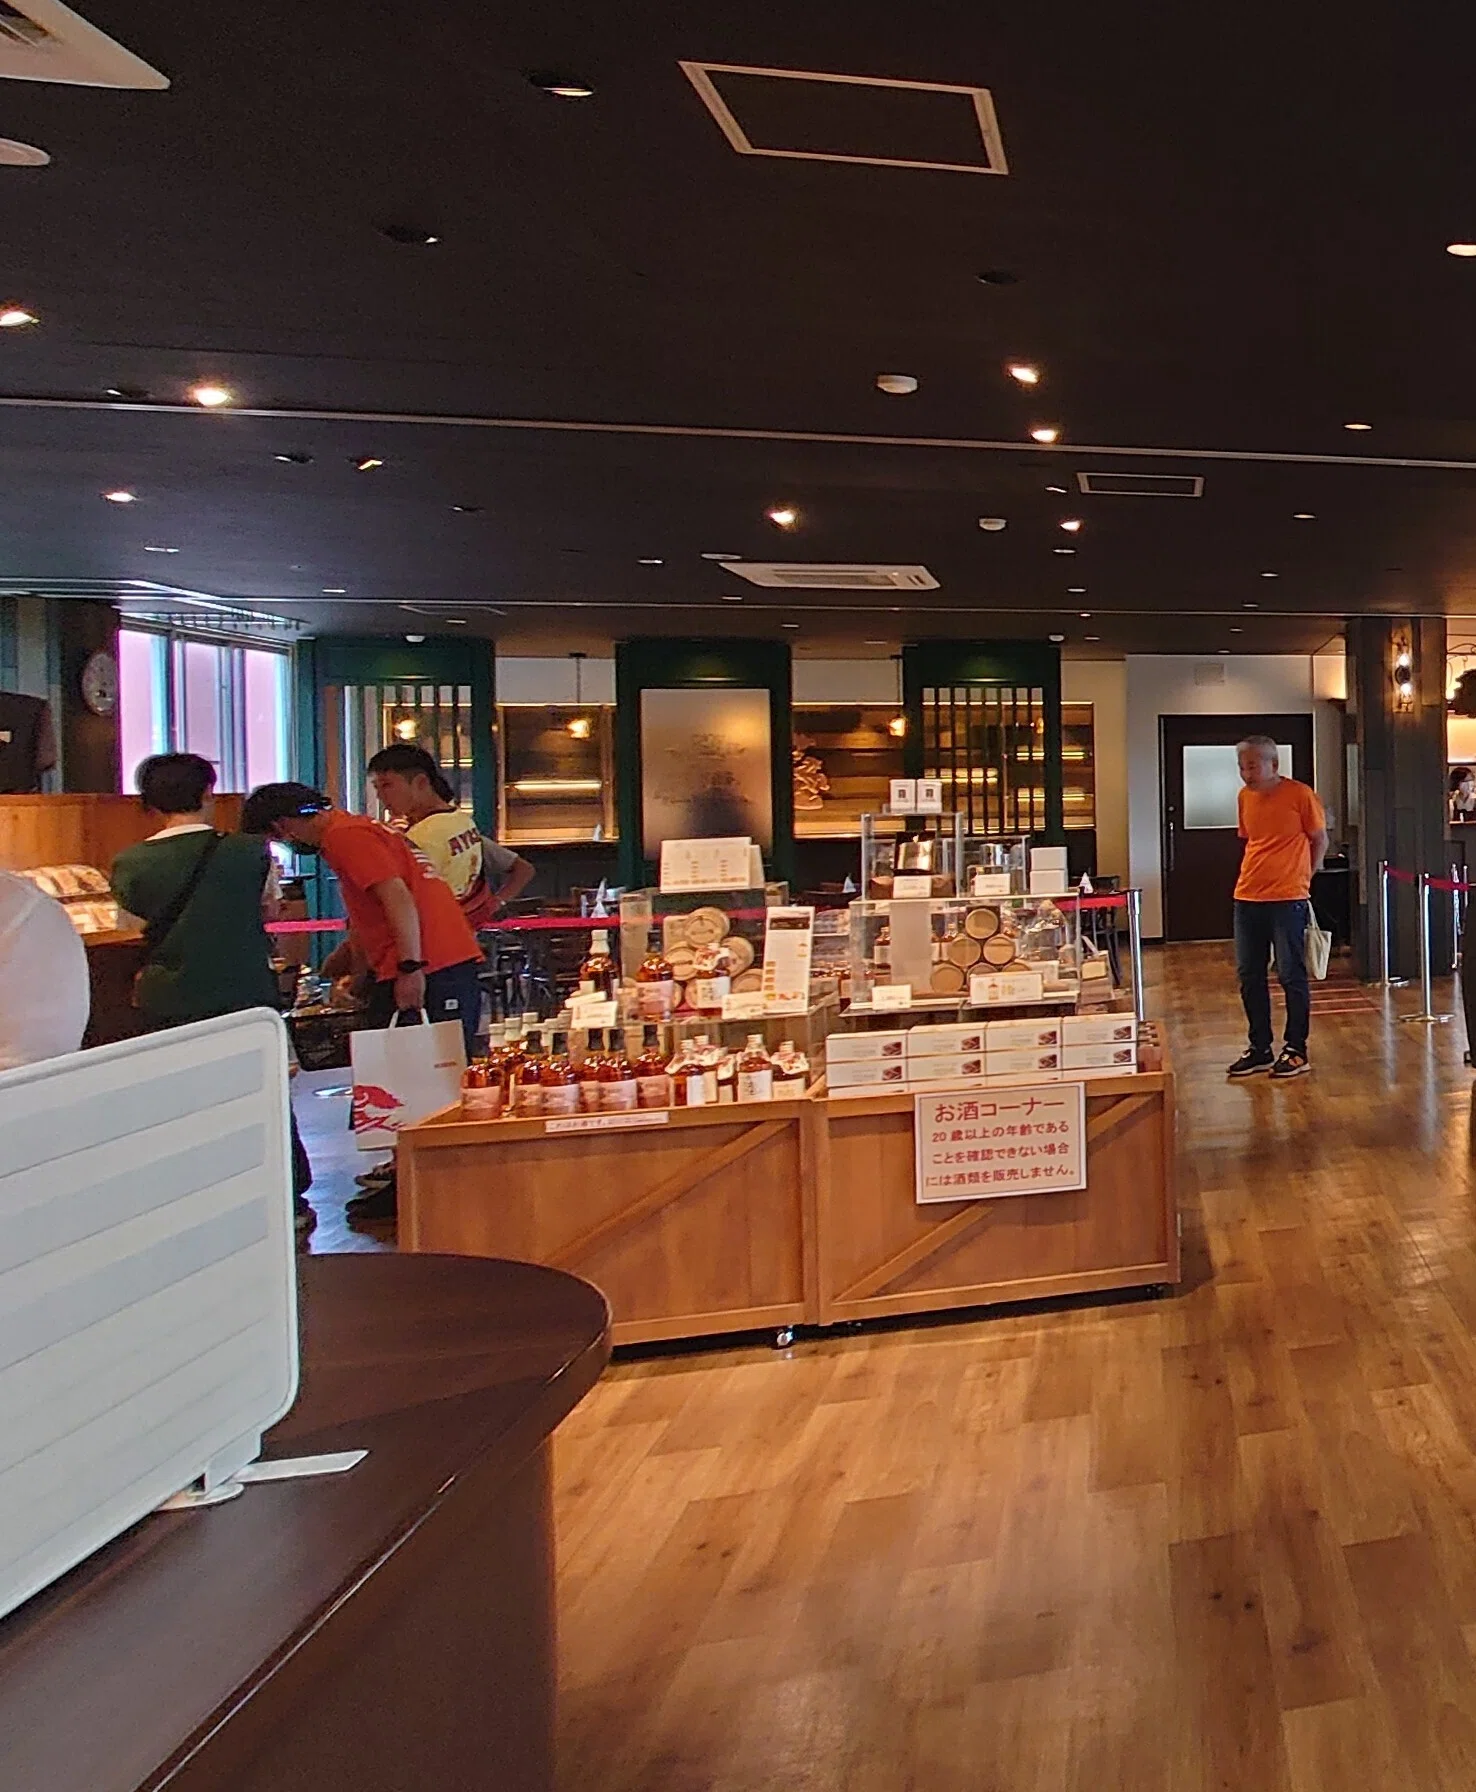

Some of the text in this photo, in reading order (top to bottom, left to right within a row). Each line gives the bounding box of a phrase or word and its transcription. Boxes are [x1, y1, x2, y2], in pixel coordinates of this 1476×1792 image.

[934, 1096, 1065, 1123] お酒コーナー
[932, 1142, 1070, 1165] ことを確認できない場合
[926, 1165, 1074, 1187] には酒類を販売しません。
